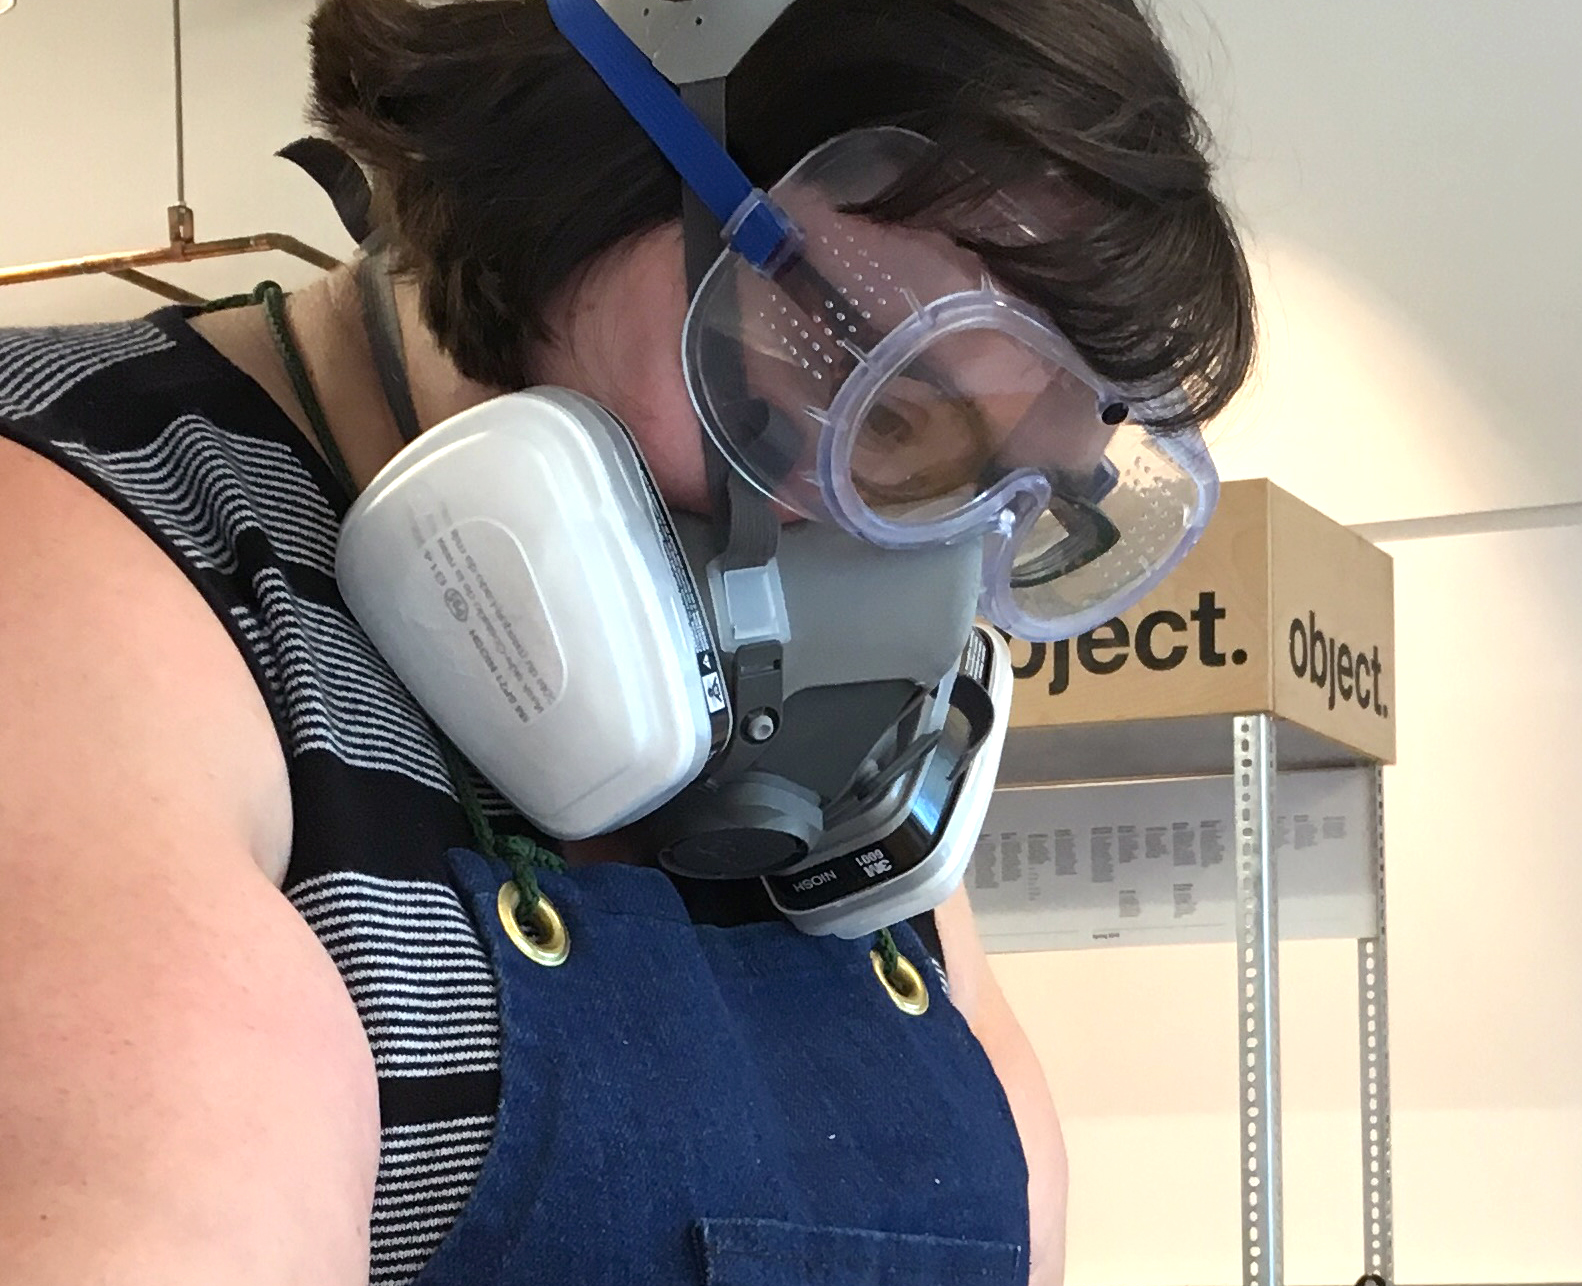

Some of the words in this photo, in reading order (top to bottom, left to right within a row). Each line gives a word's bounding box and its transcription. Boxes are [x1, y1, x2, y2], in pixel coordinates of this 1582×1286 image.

[1289, 609, 1389, 719] object.
[855, 848, 885, 867] 6001
[863, 859, 893, 878] 3M
[792, 869, 838, 893] NIOSH
